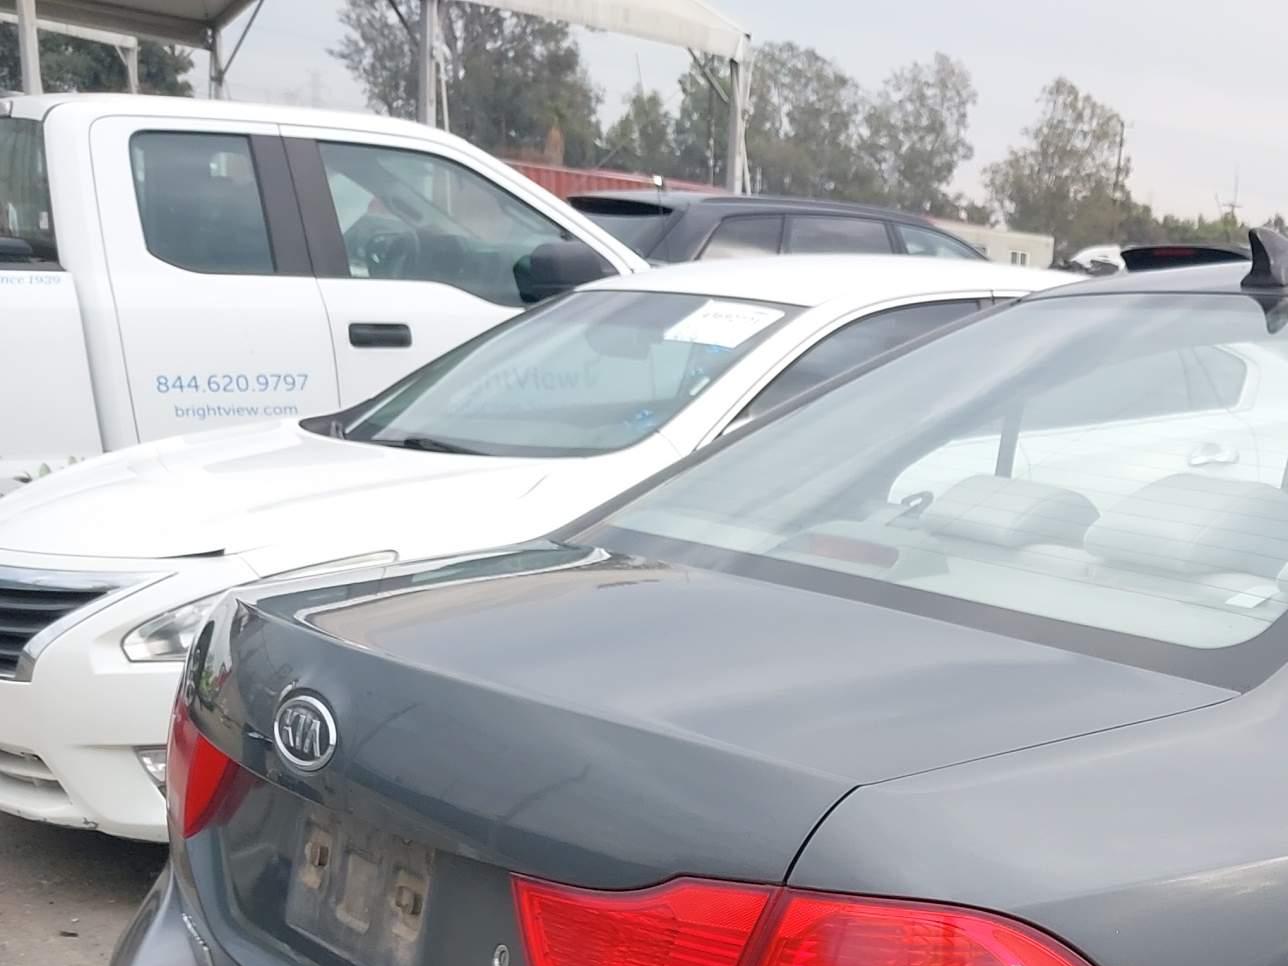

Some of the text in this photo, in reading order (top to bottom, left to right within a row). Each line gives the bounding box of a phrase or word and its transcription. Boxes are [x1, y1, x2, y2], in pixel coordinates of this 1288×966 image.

[156, 374, 309, 394] 844.620.9797
[174, 403, 299, 420] brightview.com
[283, 707, 321, 758] KIA
